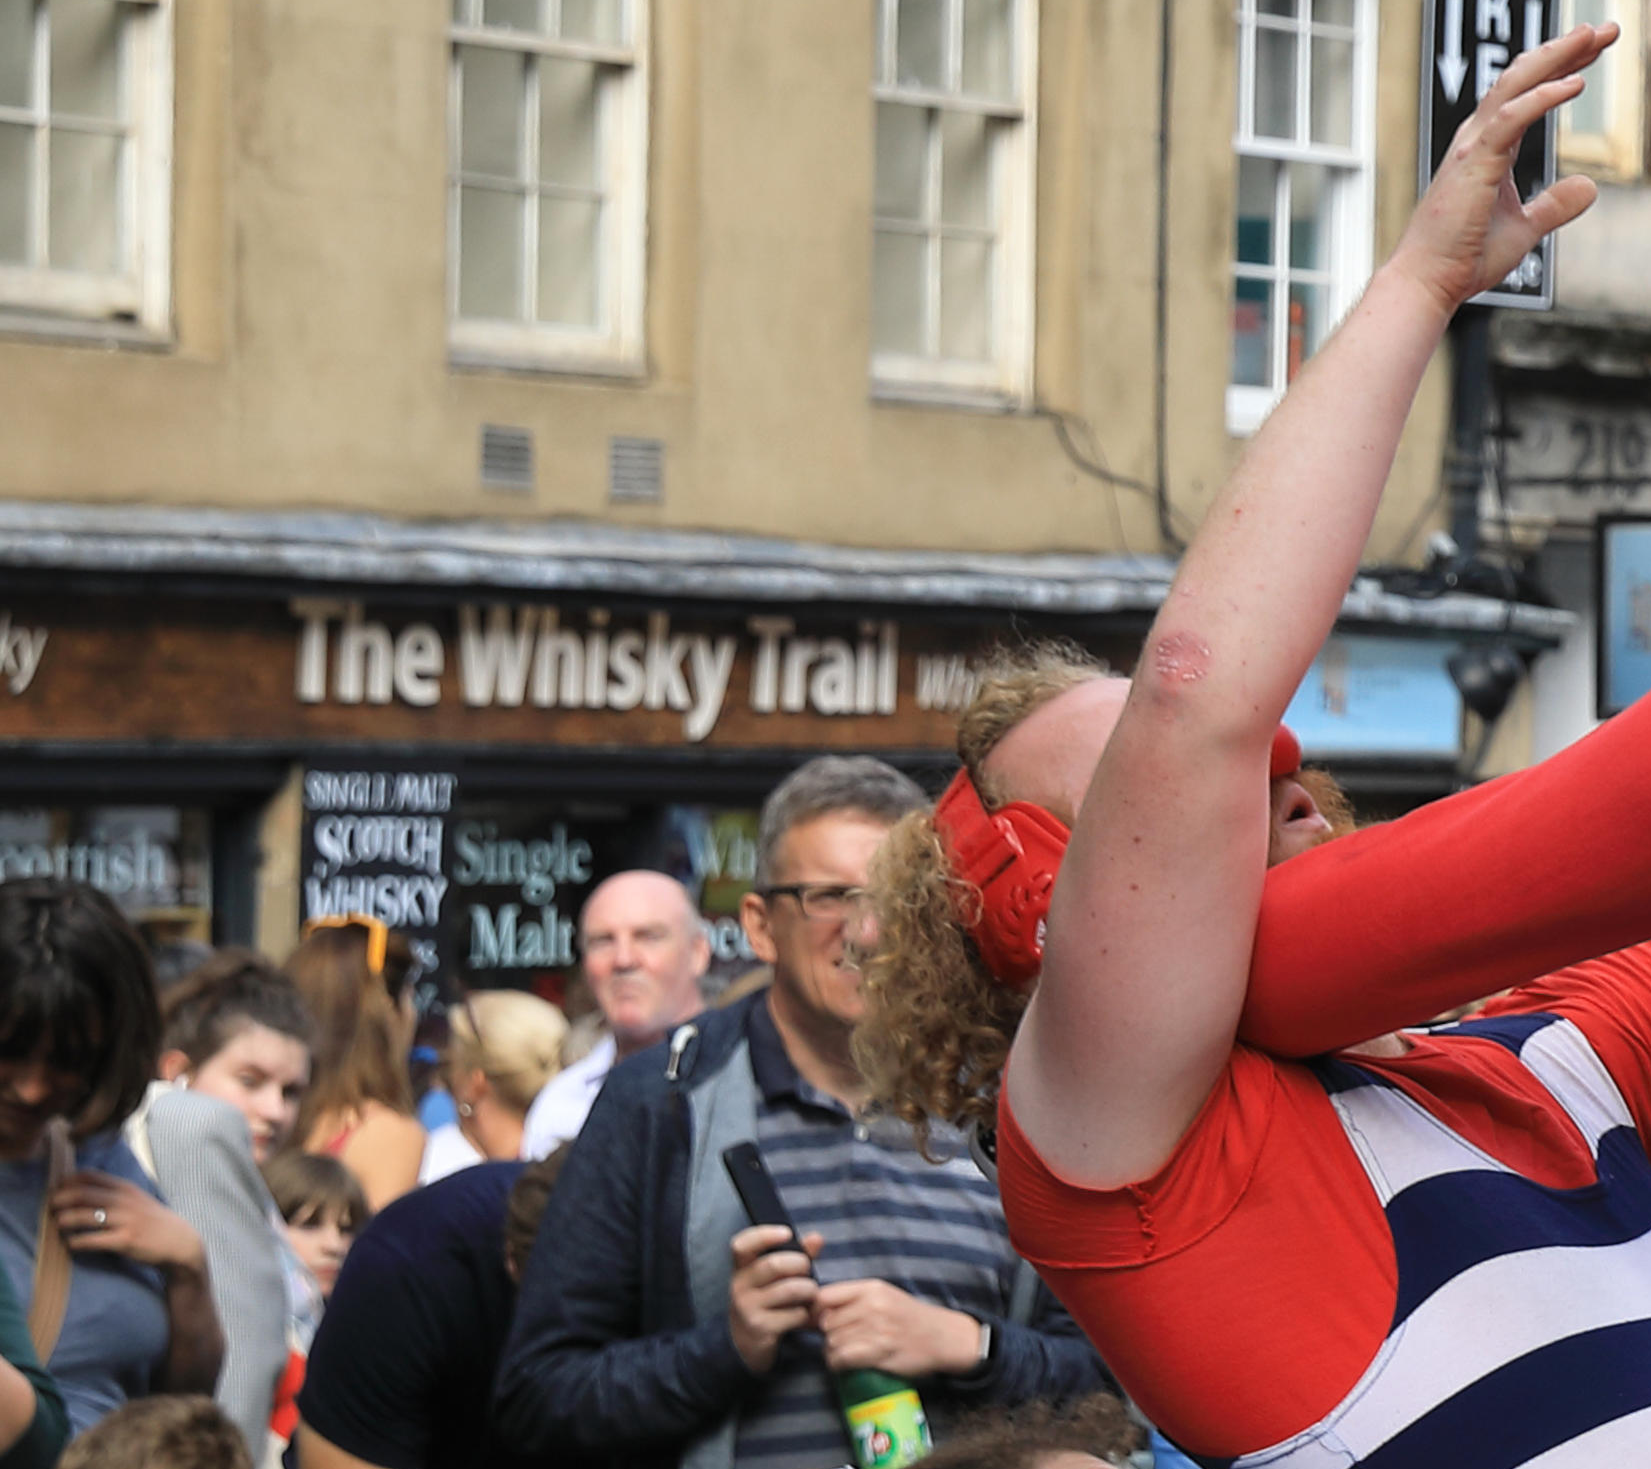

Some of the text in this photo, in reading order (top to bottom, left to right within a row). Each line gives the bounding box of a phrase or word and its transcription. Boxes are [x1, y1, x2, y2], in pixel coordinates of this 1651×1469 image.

[289, 598, 445, 706] The
[457, 604, 737, 741] Whisky
[747, 615, 899, 716] Trail
[313, 815, 445, 879] SCOTCH
[452, 820, 593, 906] Single
[305, 874, 450, 929] WHISKY
[466, 903, 578, 969] Malt
